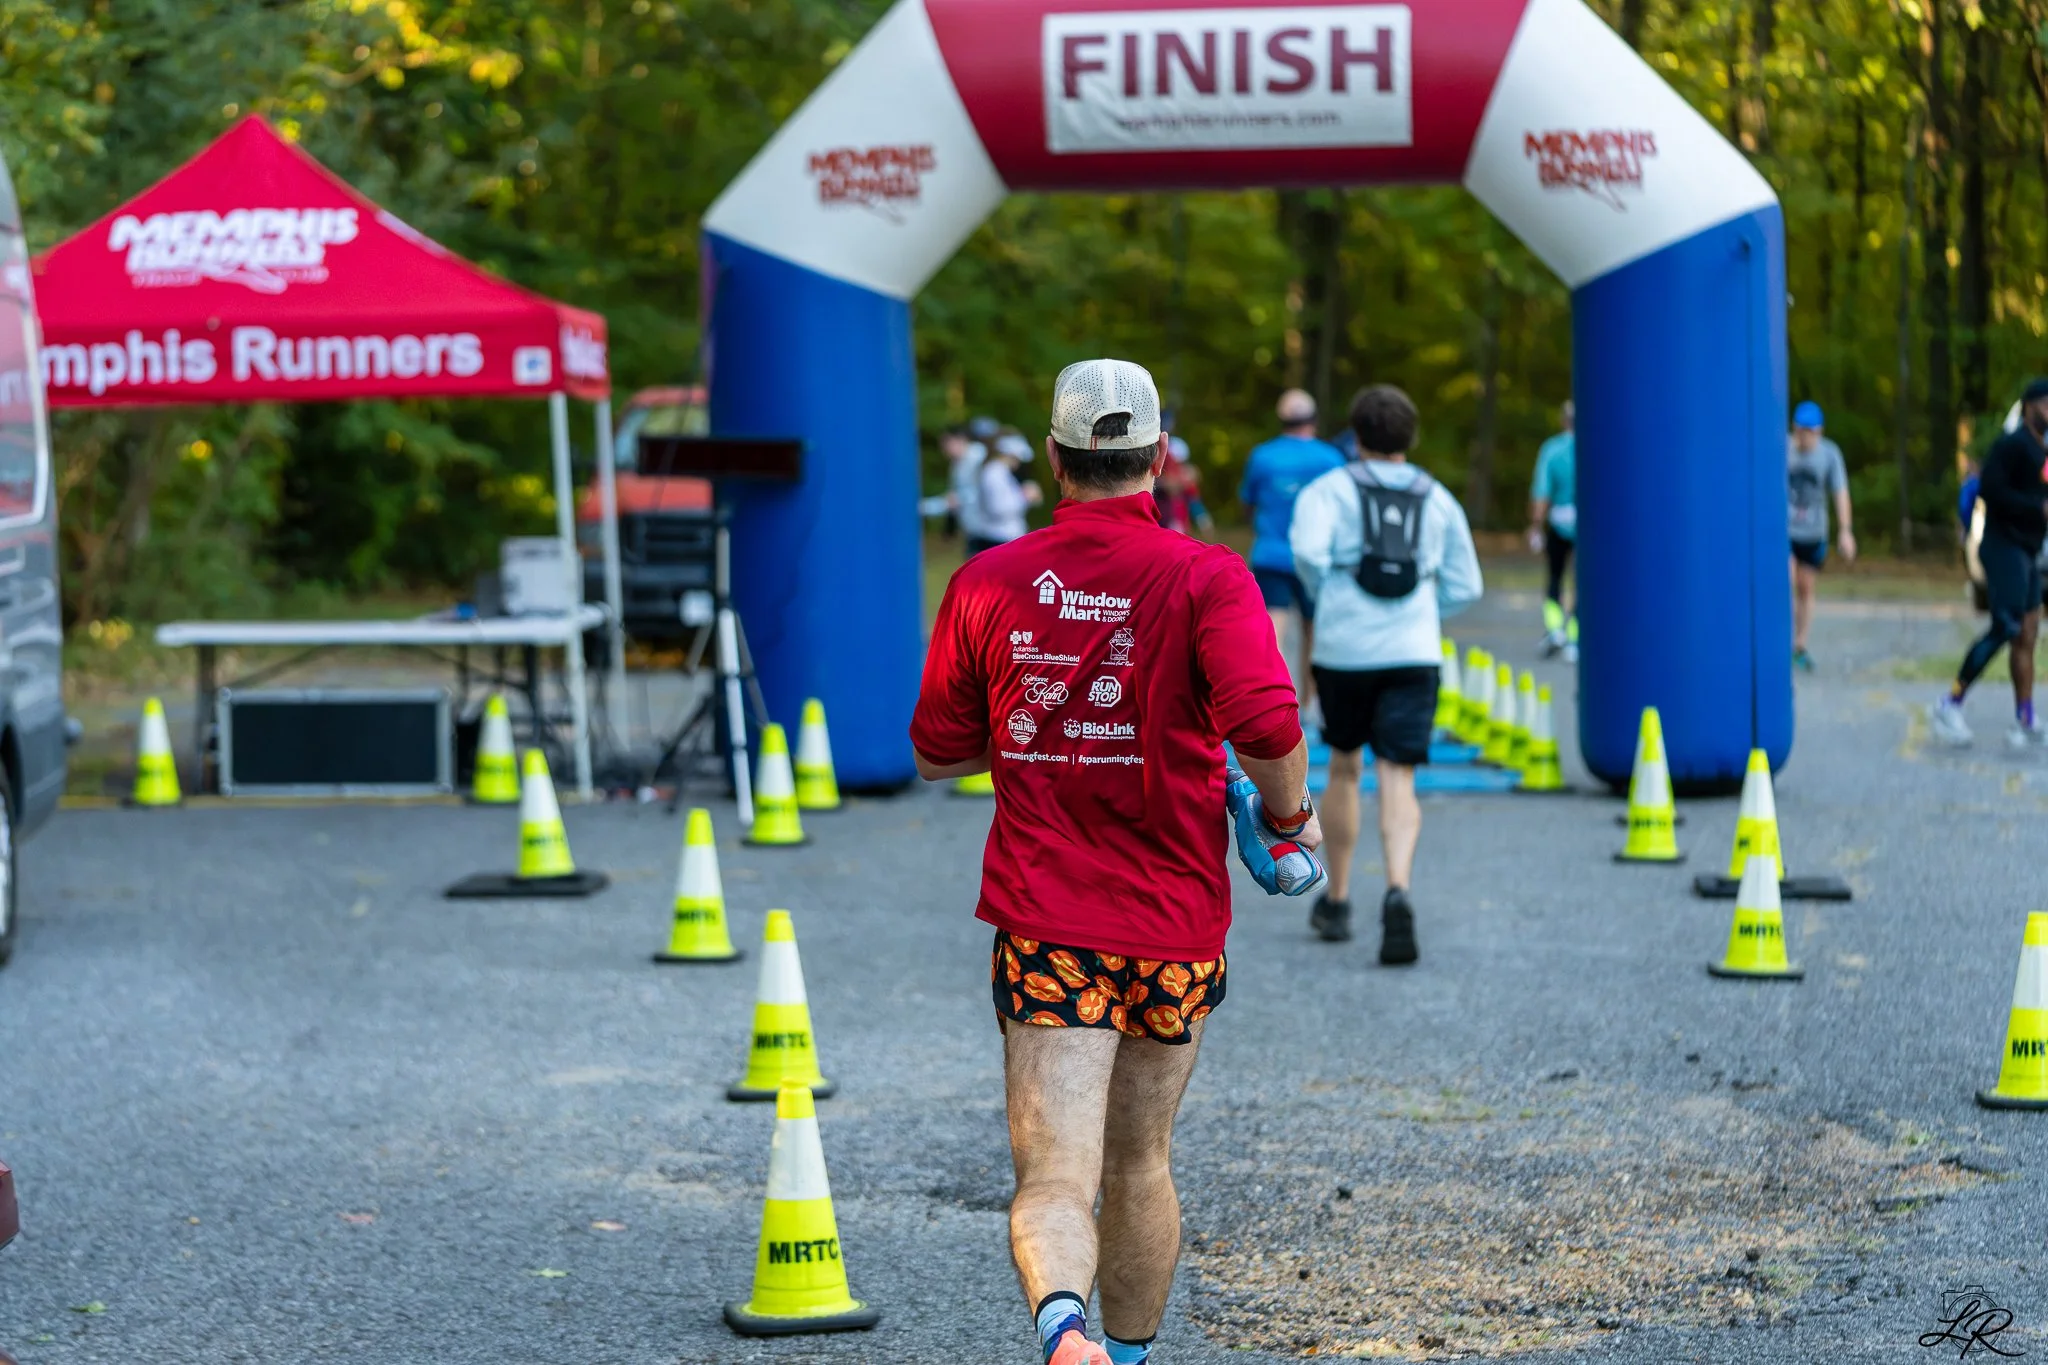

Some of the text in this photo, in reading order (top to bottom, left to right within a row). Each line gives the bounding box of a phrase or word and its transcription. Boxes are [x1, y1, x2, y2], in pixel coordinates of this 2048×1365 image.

[1061, 26, 1394, 100] FINISH
[107, 207, 359, 252] MEMPHIS
[40, 325, 485, 395] mphis Runners
[1060, 590, 1131, 609] Window
[1058, 604, 1131, 622] Mart WINDOWS
[1044, 653, 1080, 663] BlueShield
[1090, 681, 1118, 692] RUN
[1088, 691, 1117, 702] STOP
[1007, 719, 1024, 731] Trail
[1023, 721, 1038, 733] Mix
[1082, 722, 1136, 736] BioLink
[1078, 754, 1145, 766] #sparunningfest
[2012, 1038, 2048, 1059] MR
[768, 1238, 839, 1265] MRTC
